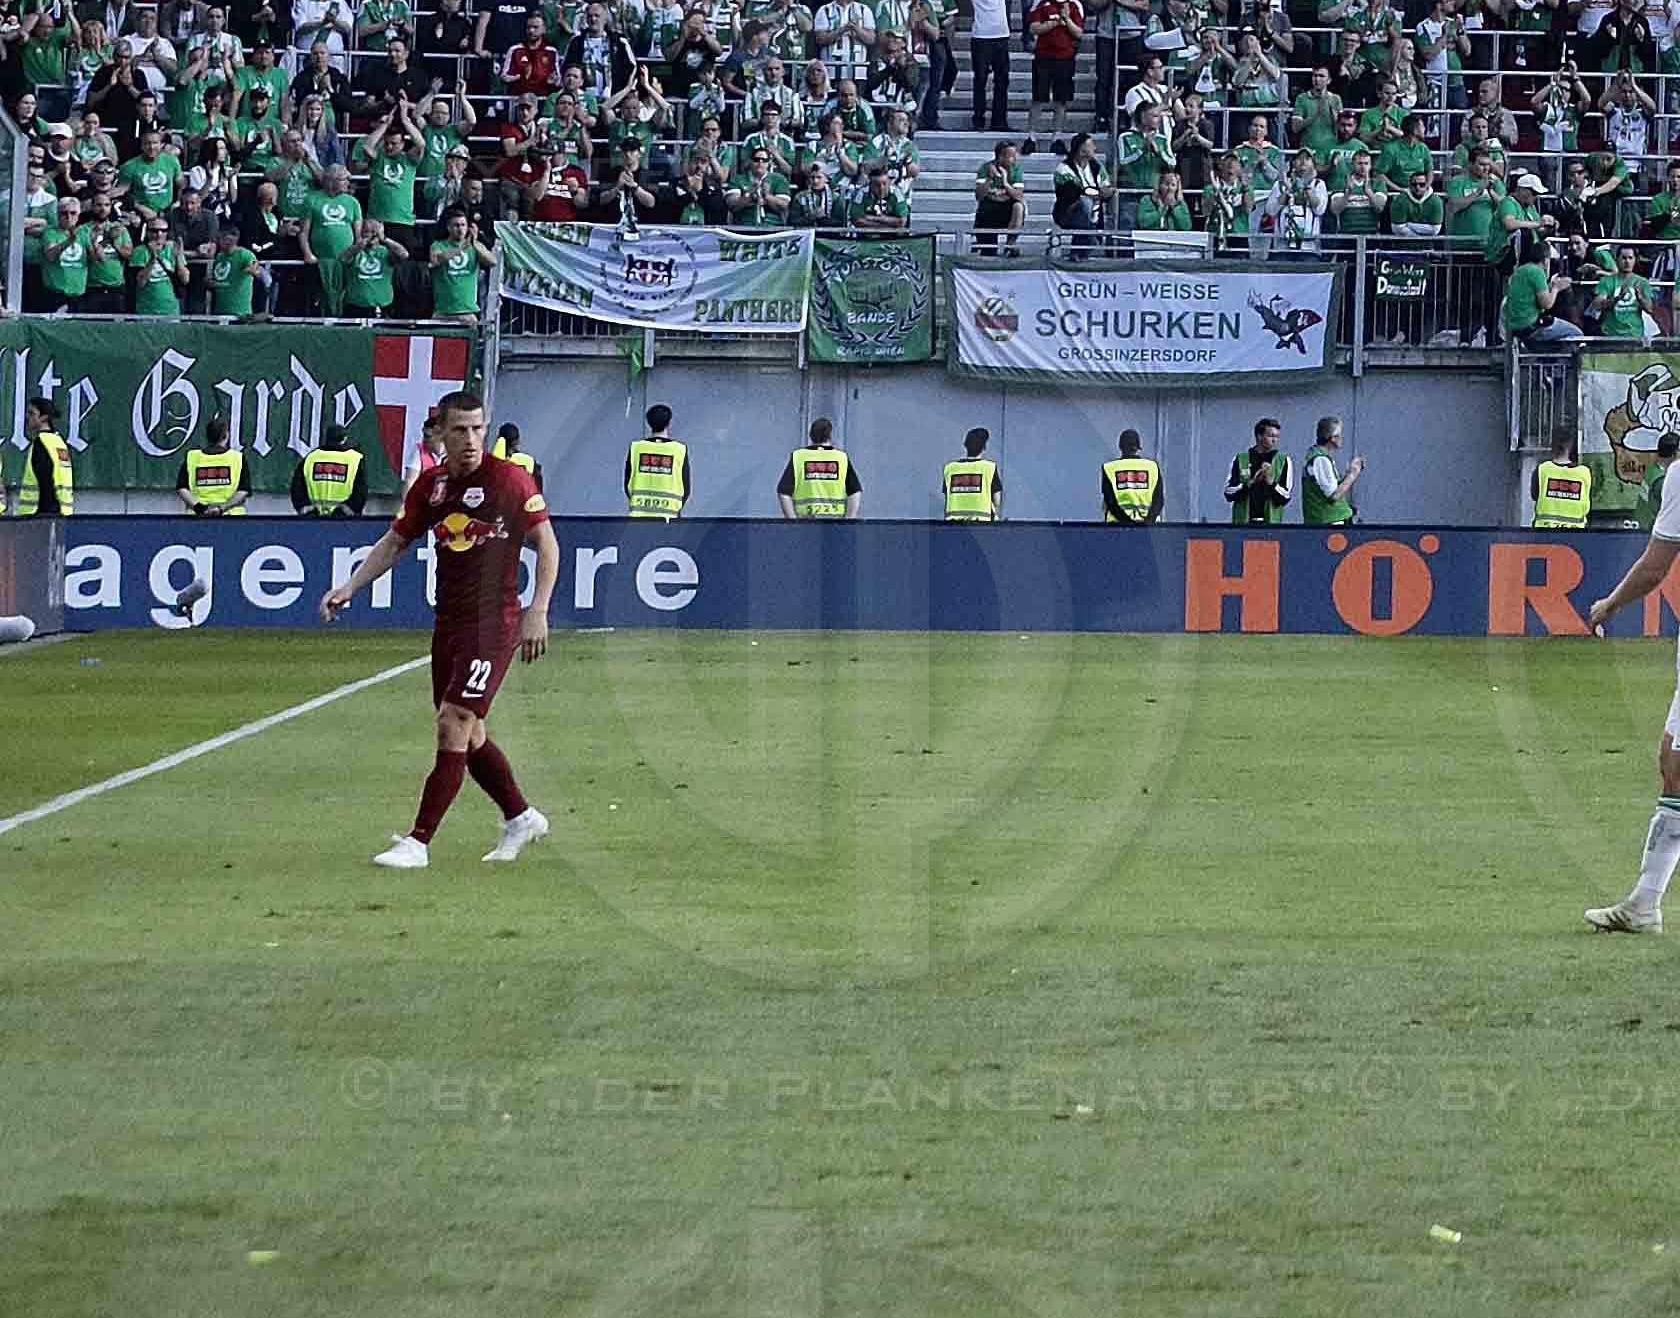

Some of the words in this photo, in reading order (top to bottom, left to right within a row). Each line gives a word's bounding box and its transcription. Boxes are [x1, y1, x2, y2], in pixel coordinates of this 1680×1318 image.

[1057, 279, 1117, 300] GRÜN
[1138, 282, 1219, 301] WEISSE
[1035, 308, 1242, 340] SCHURKEN
[1057, 346, 1217, 363] GROSSINZERSDORF
[131, 345, 365, 460] Garde
[466, 658, 492, 691] 22
